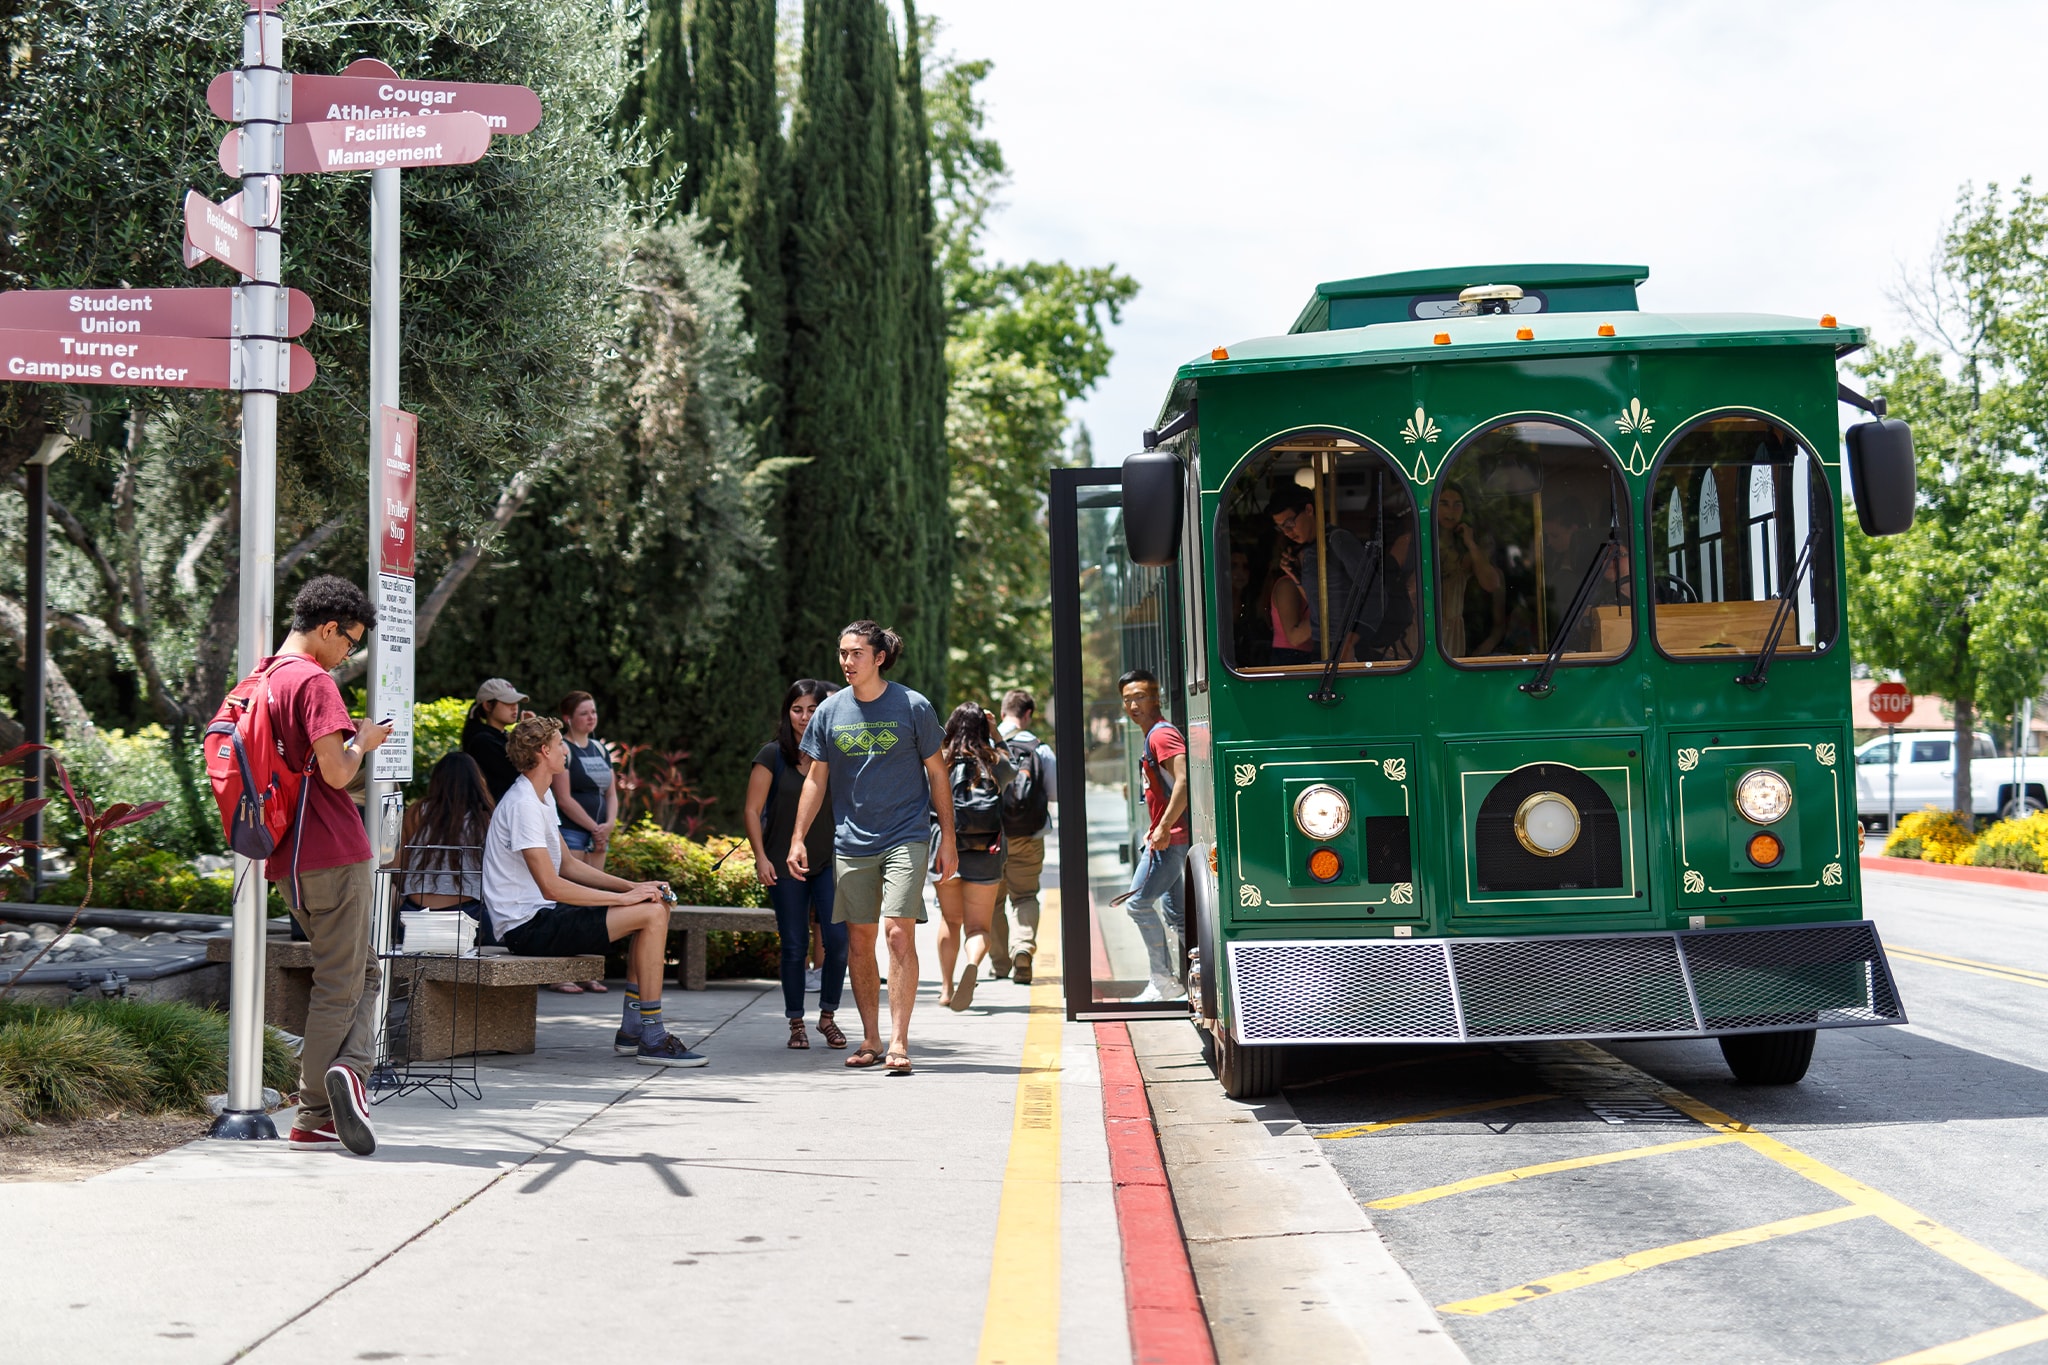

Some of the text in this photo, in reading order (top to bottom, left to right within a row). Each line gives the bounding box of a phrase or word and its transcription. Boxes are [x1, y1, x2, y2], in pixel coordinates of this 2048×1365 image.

[378, 84, 457, 106] Cougar
[345, 123, 427, 142] Facilities
[328, 143, 443, 166] Management
[206, 207, 239, 240] Residence
[214, 235, 231, 258] Halls
[69, 295, 153, 312] Student
[81, 316, 141, 333] Union
[60, 337, 139, 357] Turner
[8, 357, 188, 381] Campus Center
[386, 497, 410, 522] Trolley
[390, 520, 405, 544] Stop
[1871, 693, 1912, 713] STOP
